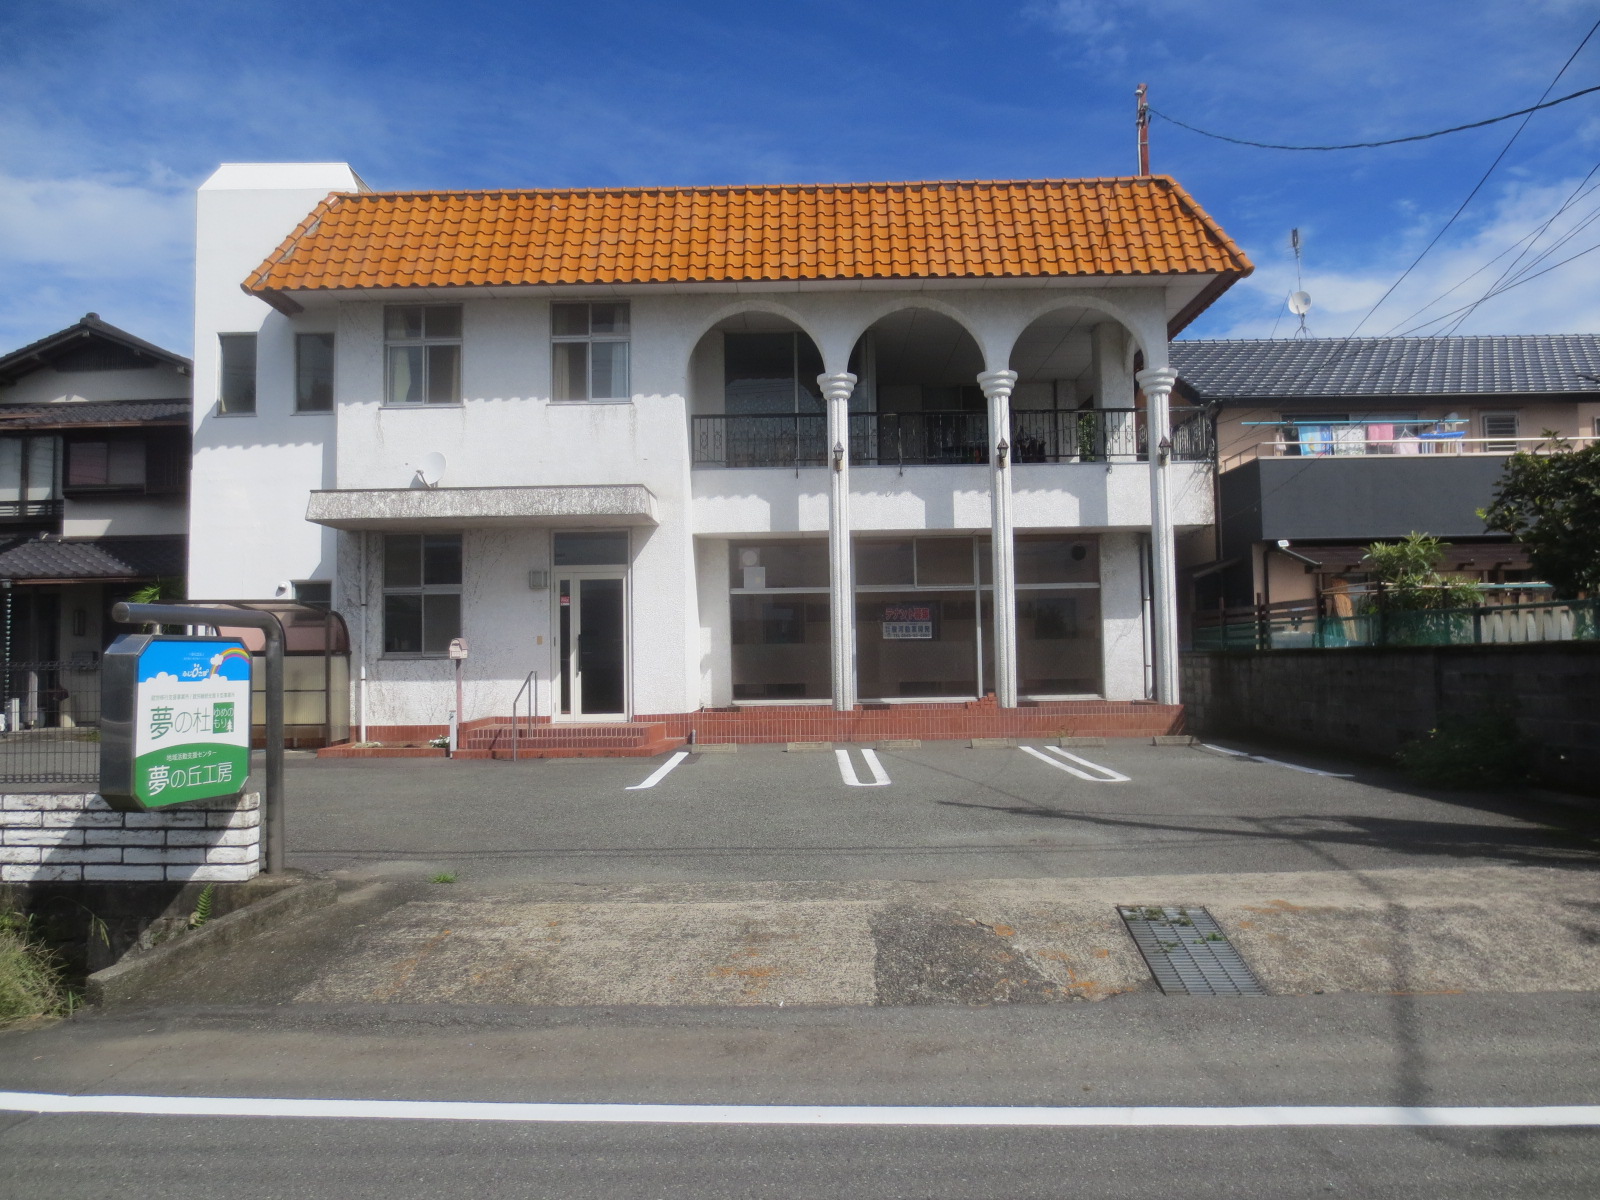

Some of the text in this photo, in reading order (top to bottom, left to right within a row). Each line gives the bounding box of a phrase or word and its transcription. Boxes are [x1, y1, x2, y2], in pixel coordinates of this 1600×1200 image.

[150, 705, 212, 740] 夢の杜
[213, 718, 227, 729] もり
[214, 707, 234, 718] ゆめの
[148, 762, 233, 796] 夢の丘工房
